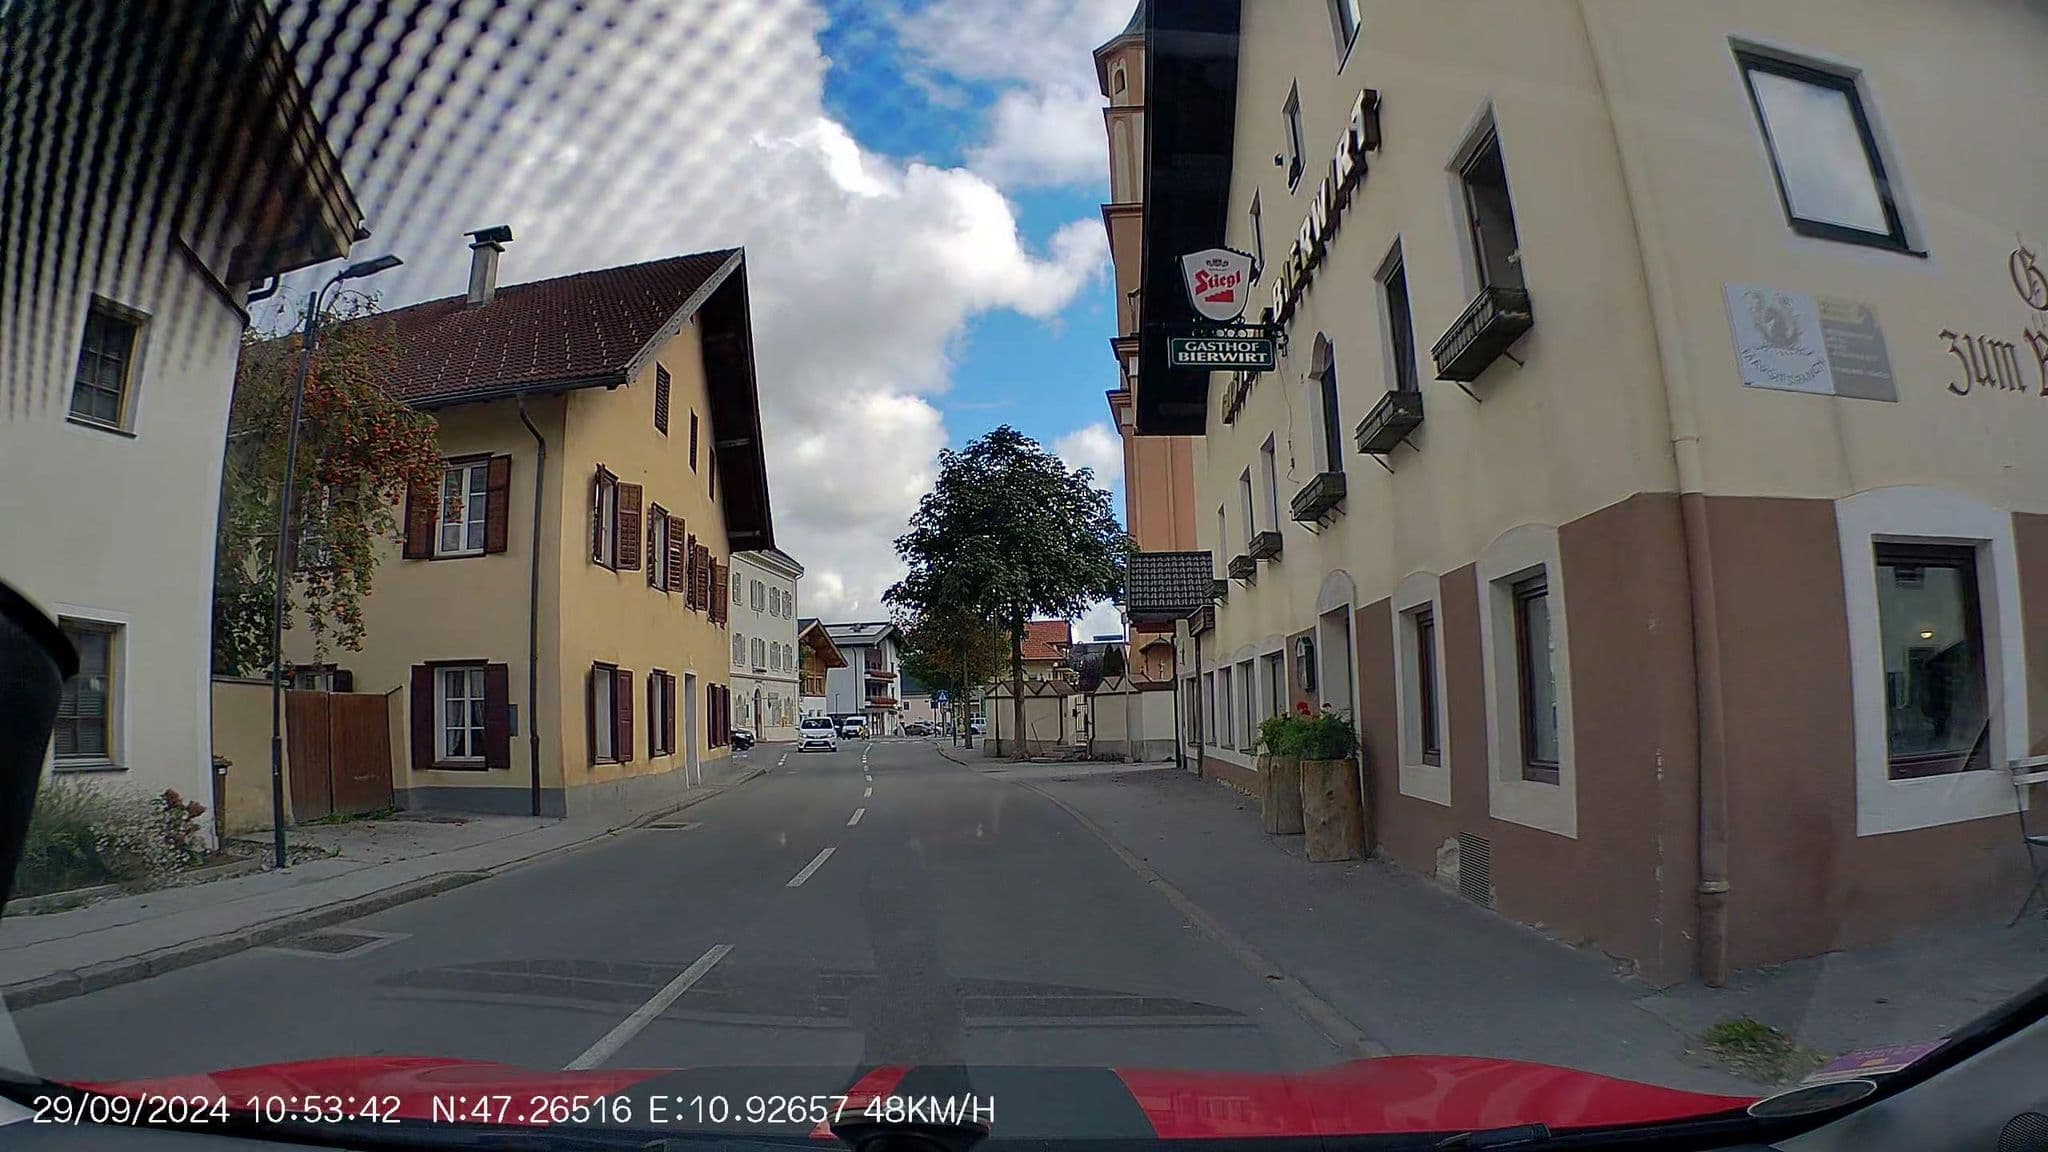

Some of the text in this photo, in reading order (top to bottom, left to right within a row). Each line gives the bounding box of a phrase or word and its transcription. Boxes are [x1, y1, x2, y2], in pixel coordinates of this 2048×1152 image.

[1195, 268, 1241, 295] Stiegl
[1185, 341, 1260, 351] GASTHOF
[1179, 352, 1267, 362] BIERWIRT
